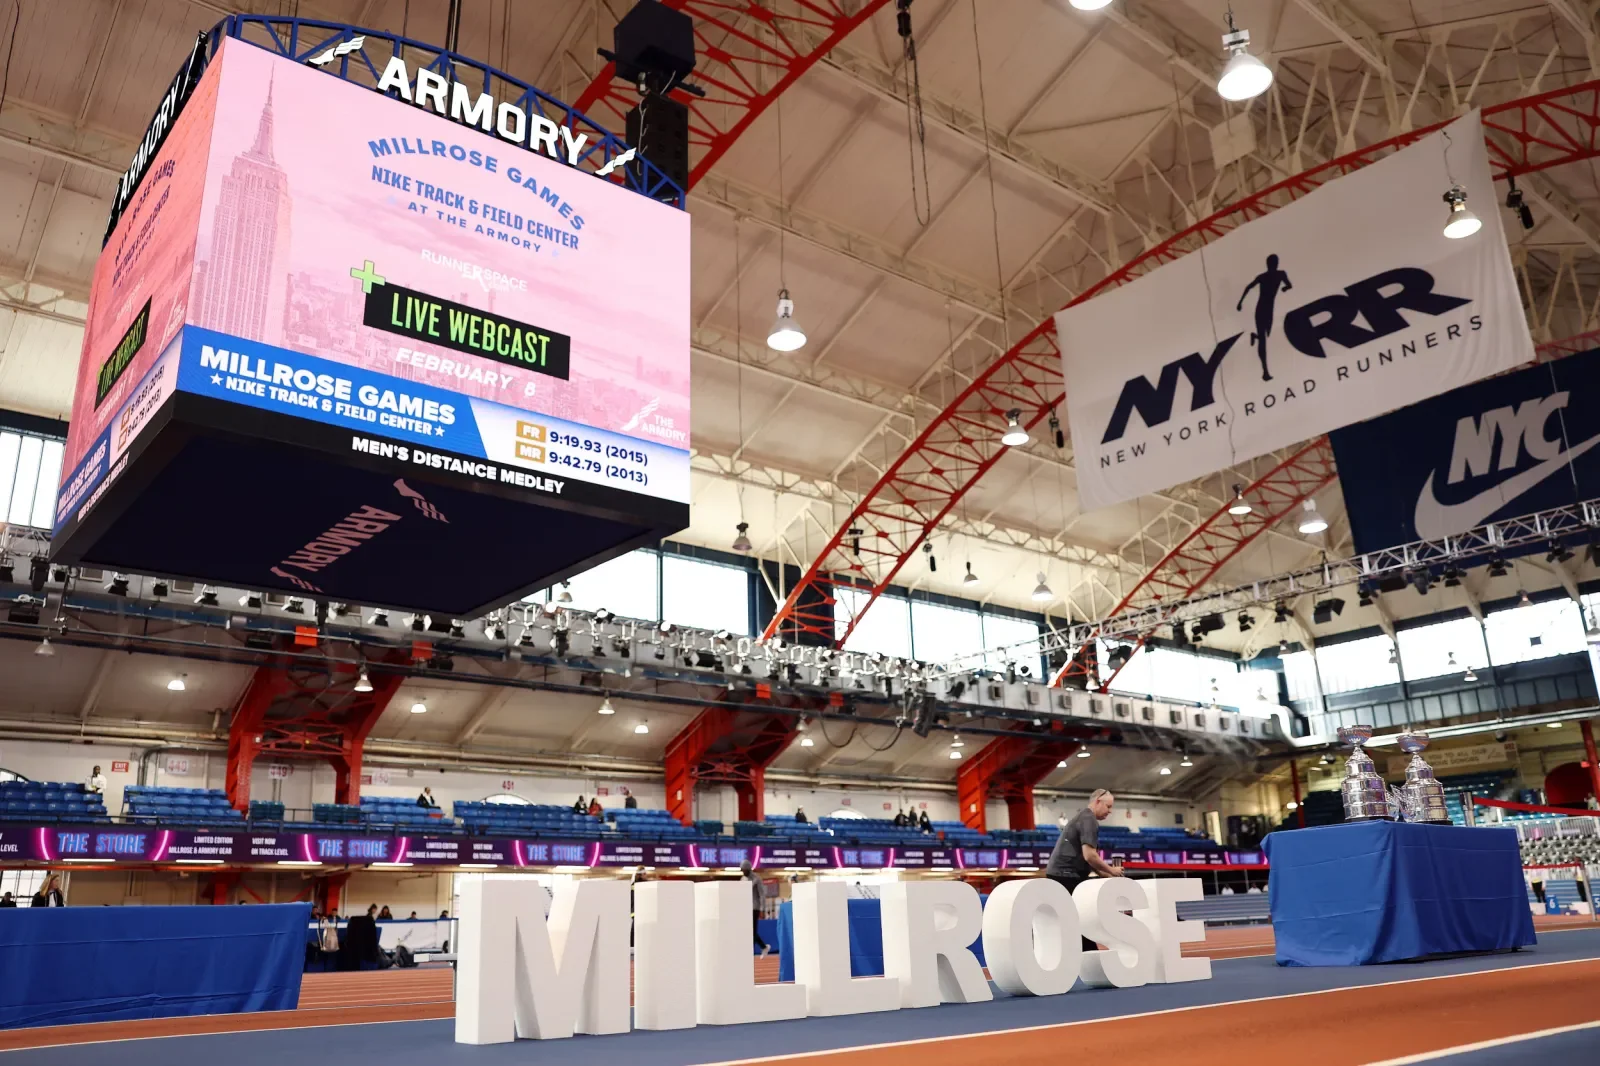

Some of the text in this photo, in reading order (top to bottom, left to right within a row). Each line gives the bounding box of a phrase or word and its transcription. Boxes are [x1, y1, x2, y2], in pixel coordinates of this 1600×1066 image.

[377, 55, 589, 166] ARMORY
[118, 75, 180, 210] ARMORY
[368, 137, 585, 231] MILLROSE GAMES
[371, 165, 579, 250] NIKE TRACK & FIELD CENTER
[408, 201, 542, 253] AT THE ARMORY
[421, 248, 528, 293] RUNNERSPACE
[391, 292, 551, 367] LIVE WEBCAST
[199, 344, 456, 425] MILLROSE GAMES
[395, 347, 514, 390] FEBRUARY
[1100, 315, 1483, 469] NEW YORK ROAD RUNNERS
[225, 376, 432, 436] NIKE TRACK & FIELD CENTER
[641, 414, 686, 442] THE ARMORY
[352, 436, 565, 494] MEN'S DISTANCE MEDLEY
[520, 445, 649, 486] MR 9:42.79 (2013)
[522, 424, 649, 466] FR 9:19.93 (2015)
[1447, 391, 1570, 485] NYC
[281, 504, 403, 572] ARMORY
[0, 844, 18, 852] LEVEL
[57, 832, 146, 853] THE STORE
[318, 839, 388, 858] THE STORE
[527, 845, 584, 861] THE STORE
[1549, 899, 1556, 909] 6
[455, 877, 1213, 1045] MILLROSE
